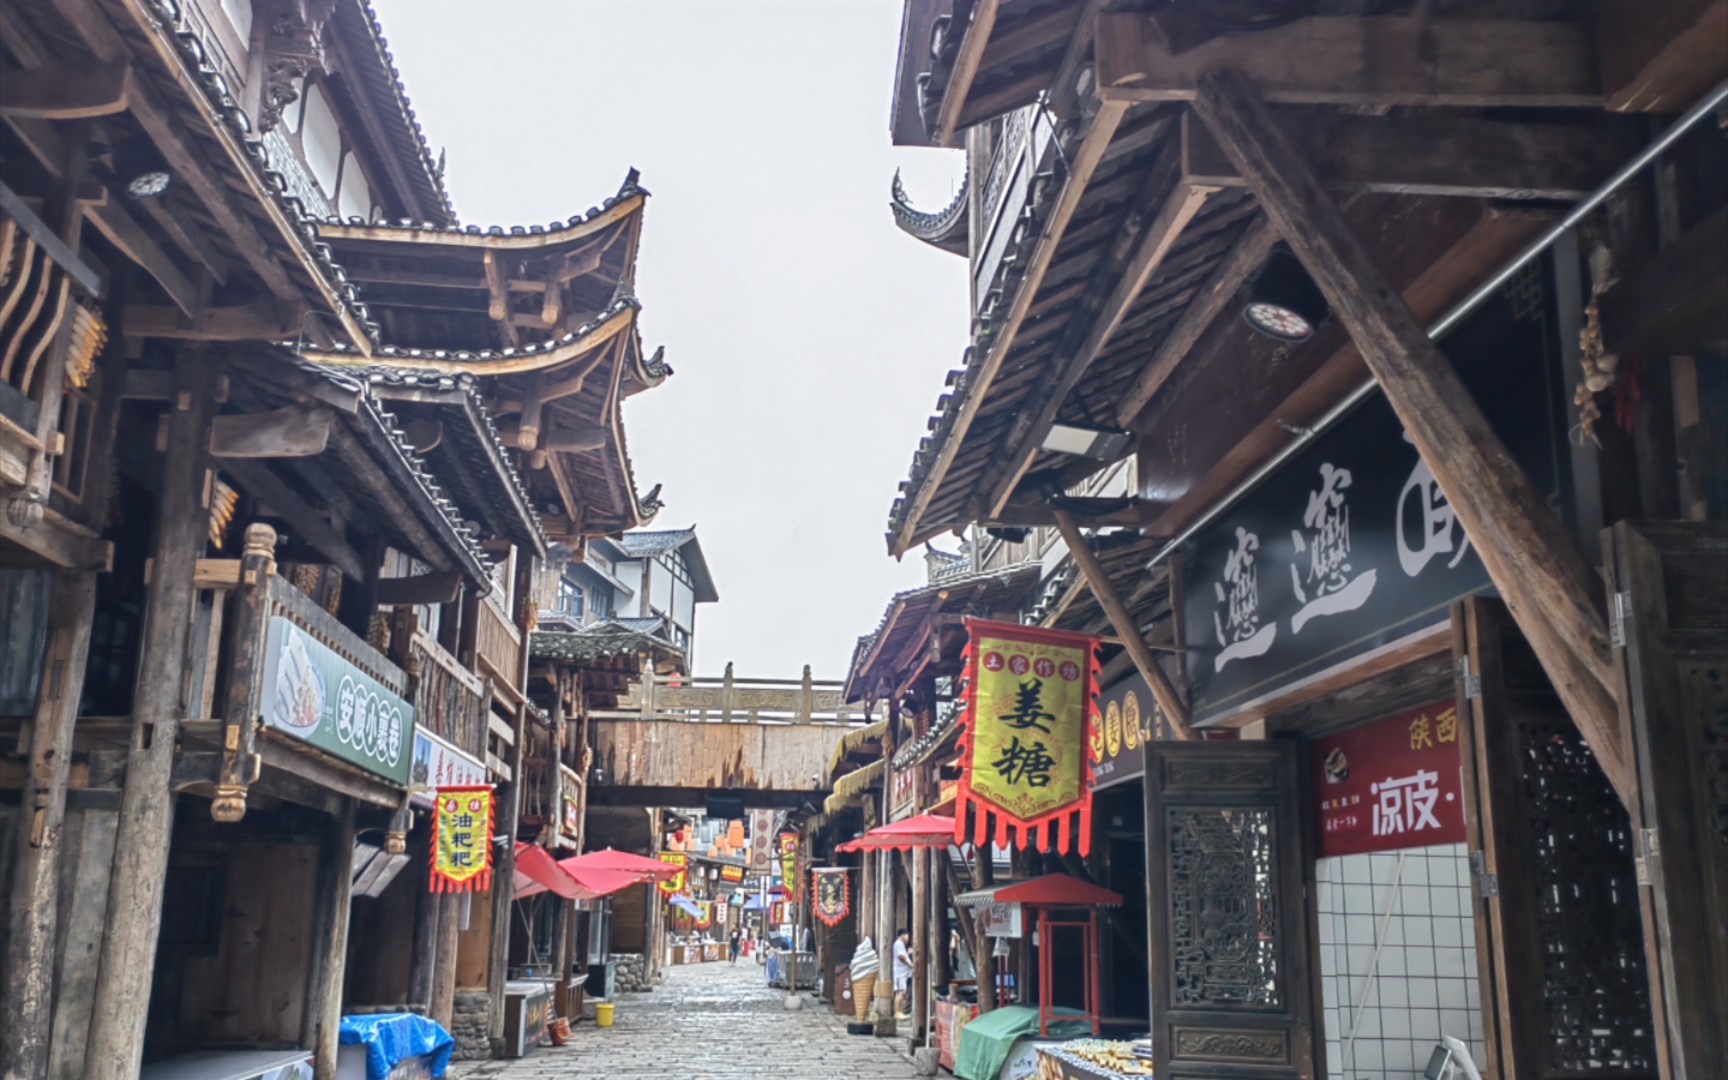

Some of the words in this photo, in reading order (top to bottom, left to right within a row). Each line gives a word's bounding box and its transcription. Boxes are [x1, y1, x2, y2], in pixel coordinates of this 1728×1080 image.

[985, 653, 1078, 680] 土家作坊
[338, 682, 400, 762] 安顺小裹卷
[992, 677, 1056, 788] 姜糖
[1408, 707, 1457, 751] 陕西
[450, 812, 474, 867] 油粑粑
